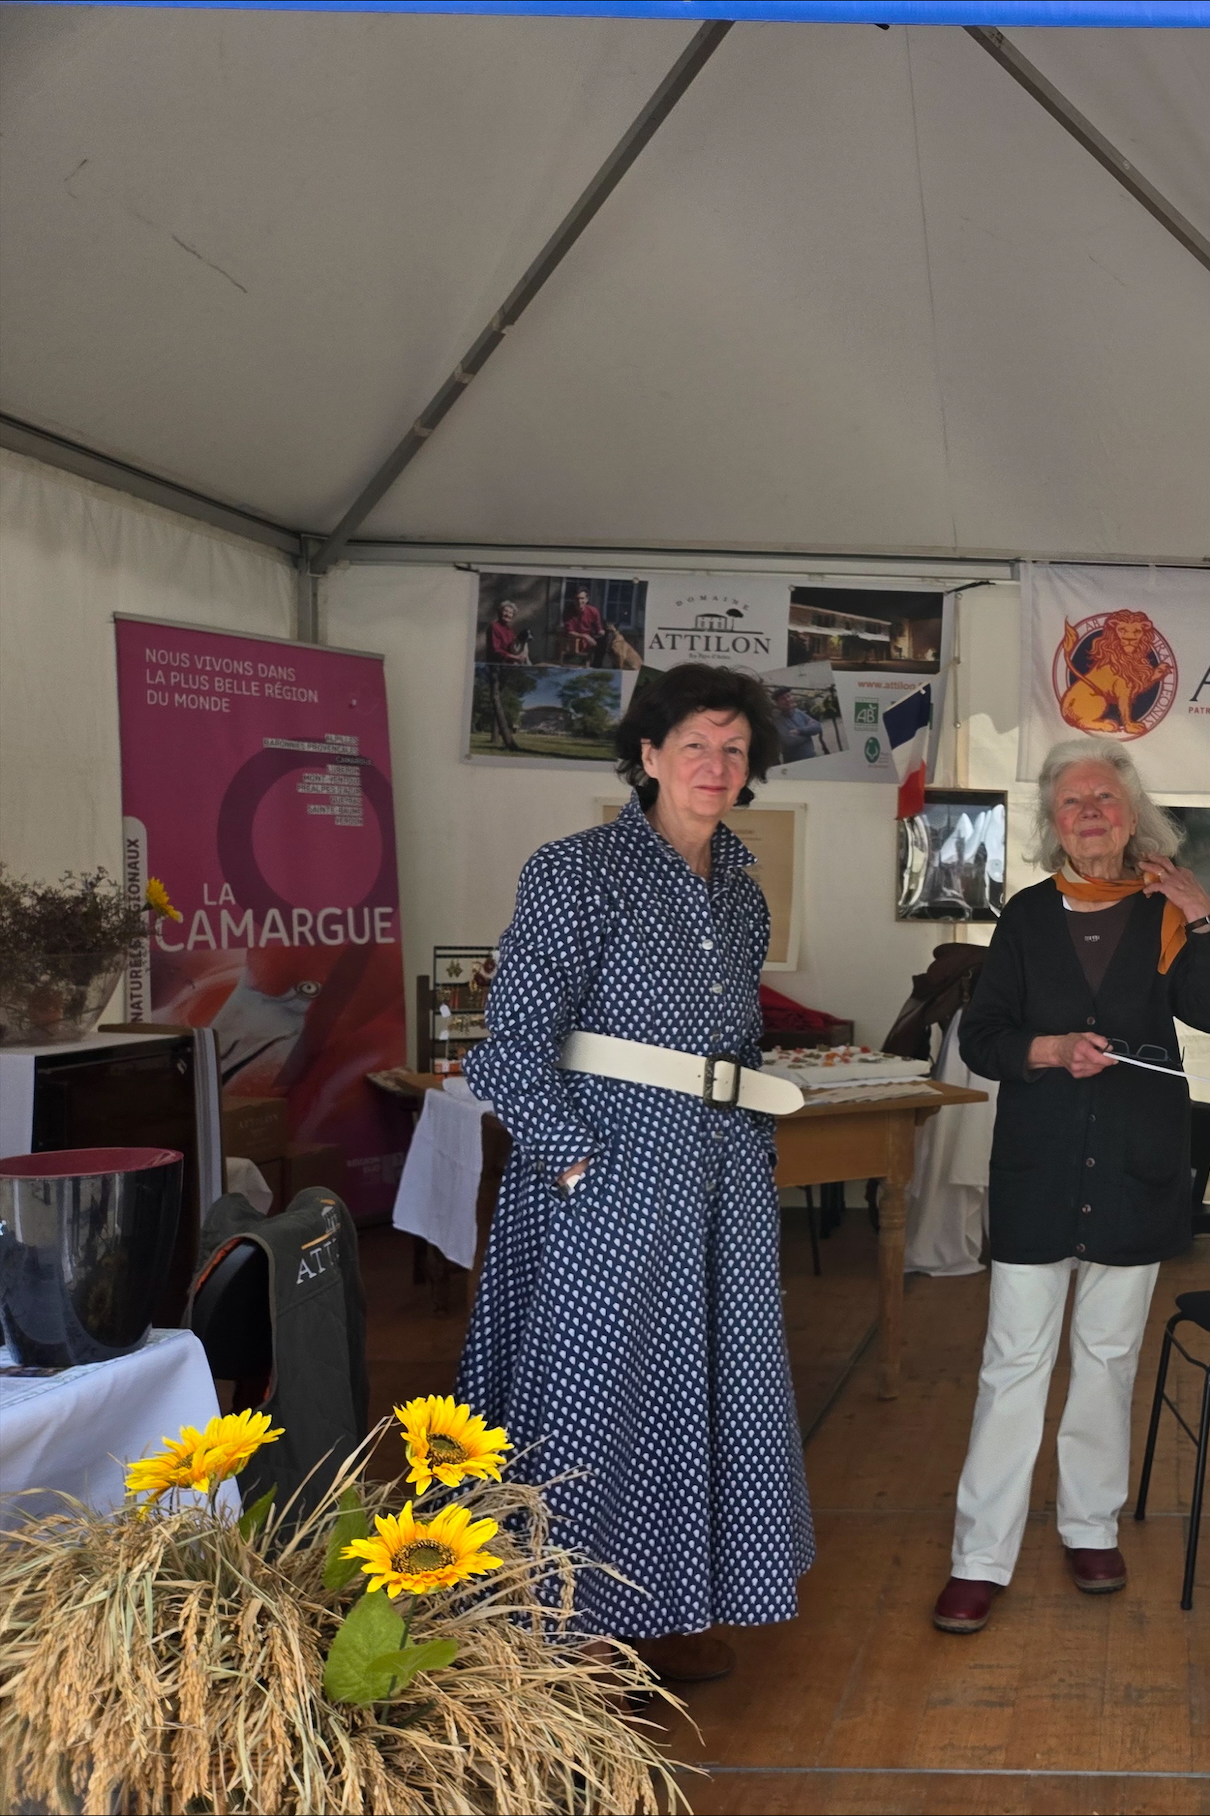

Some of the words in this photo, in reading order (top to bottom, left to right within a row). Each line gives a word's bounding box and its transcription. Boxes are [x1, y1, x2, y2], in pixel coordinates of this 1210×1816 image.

[675, 594, 750, 611] DOMAINE
[1085, 619, 1100, 631] AB
[648, 632, 771, 655] ATTILON
[145, 648, 190, 669] NOUS
[194, 655, 253, 676] VIVONS
[257, 663, 296, 682] DANS
[146, 669, 166, 686] LA
[170, 672, 210, 692] PLUS
[214, 678, 260, 697] BELLE
[264, 682, 319, 704] RÉGION
[147, 690, 170, 706] DU
[174, 694, 231, 712] MONDE
[127, 838, 140, 912] GIONAUX
[203, 882, 236, 905] LA
[154, 906, 396, 951] CAMARGUE
